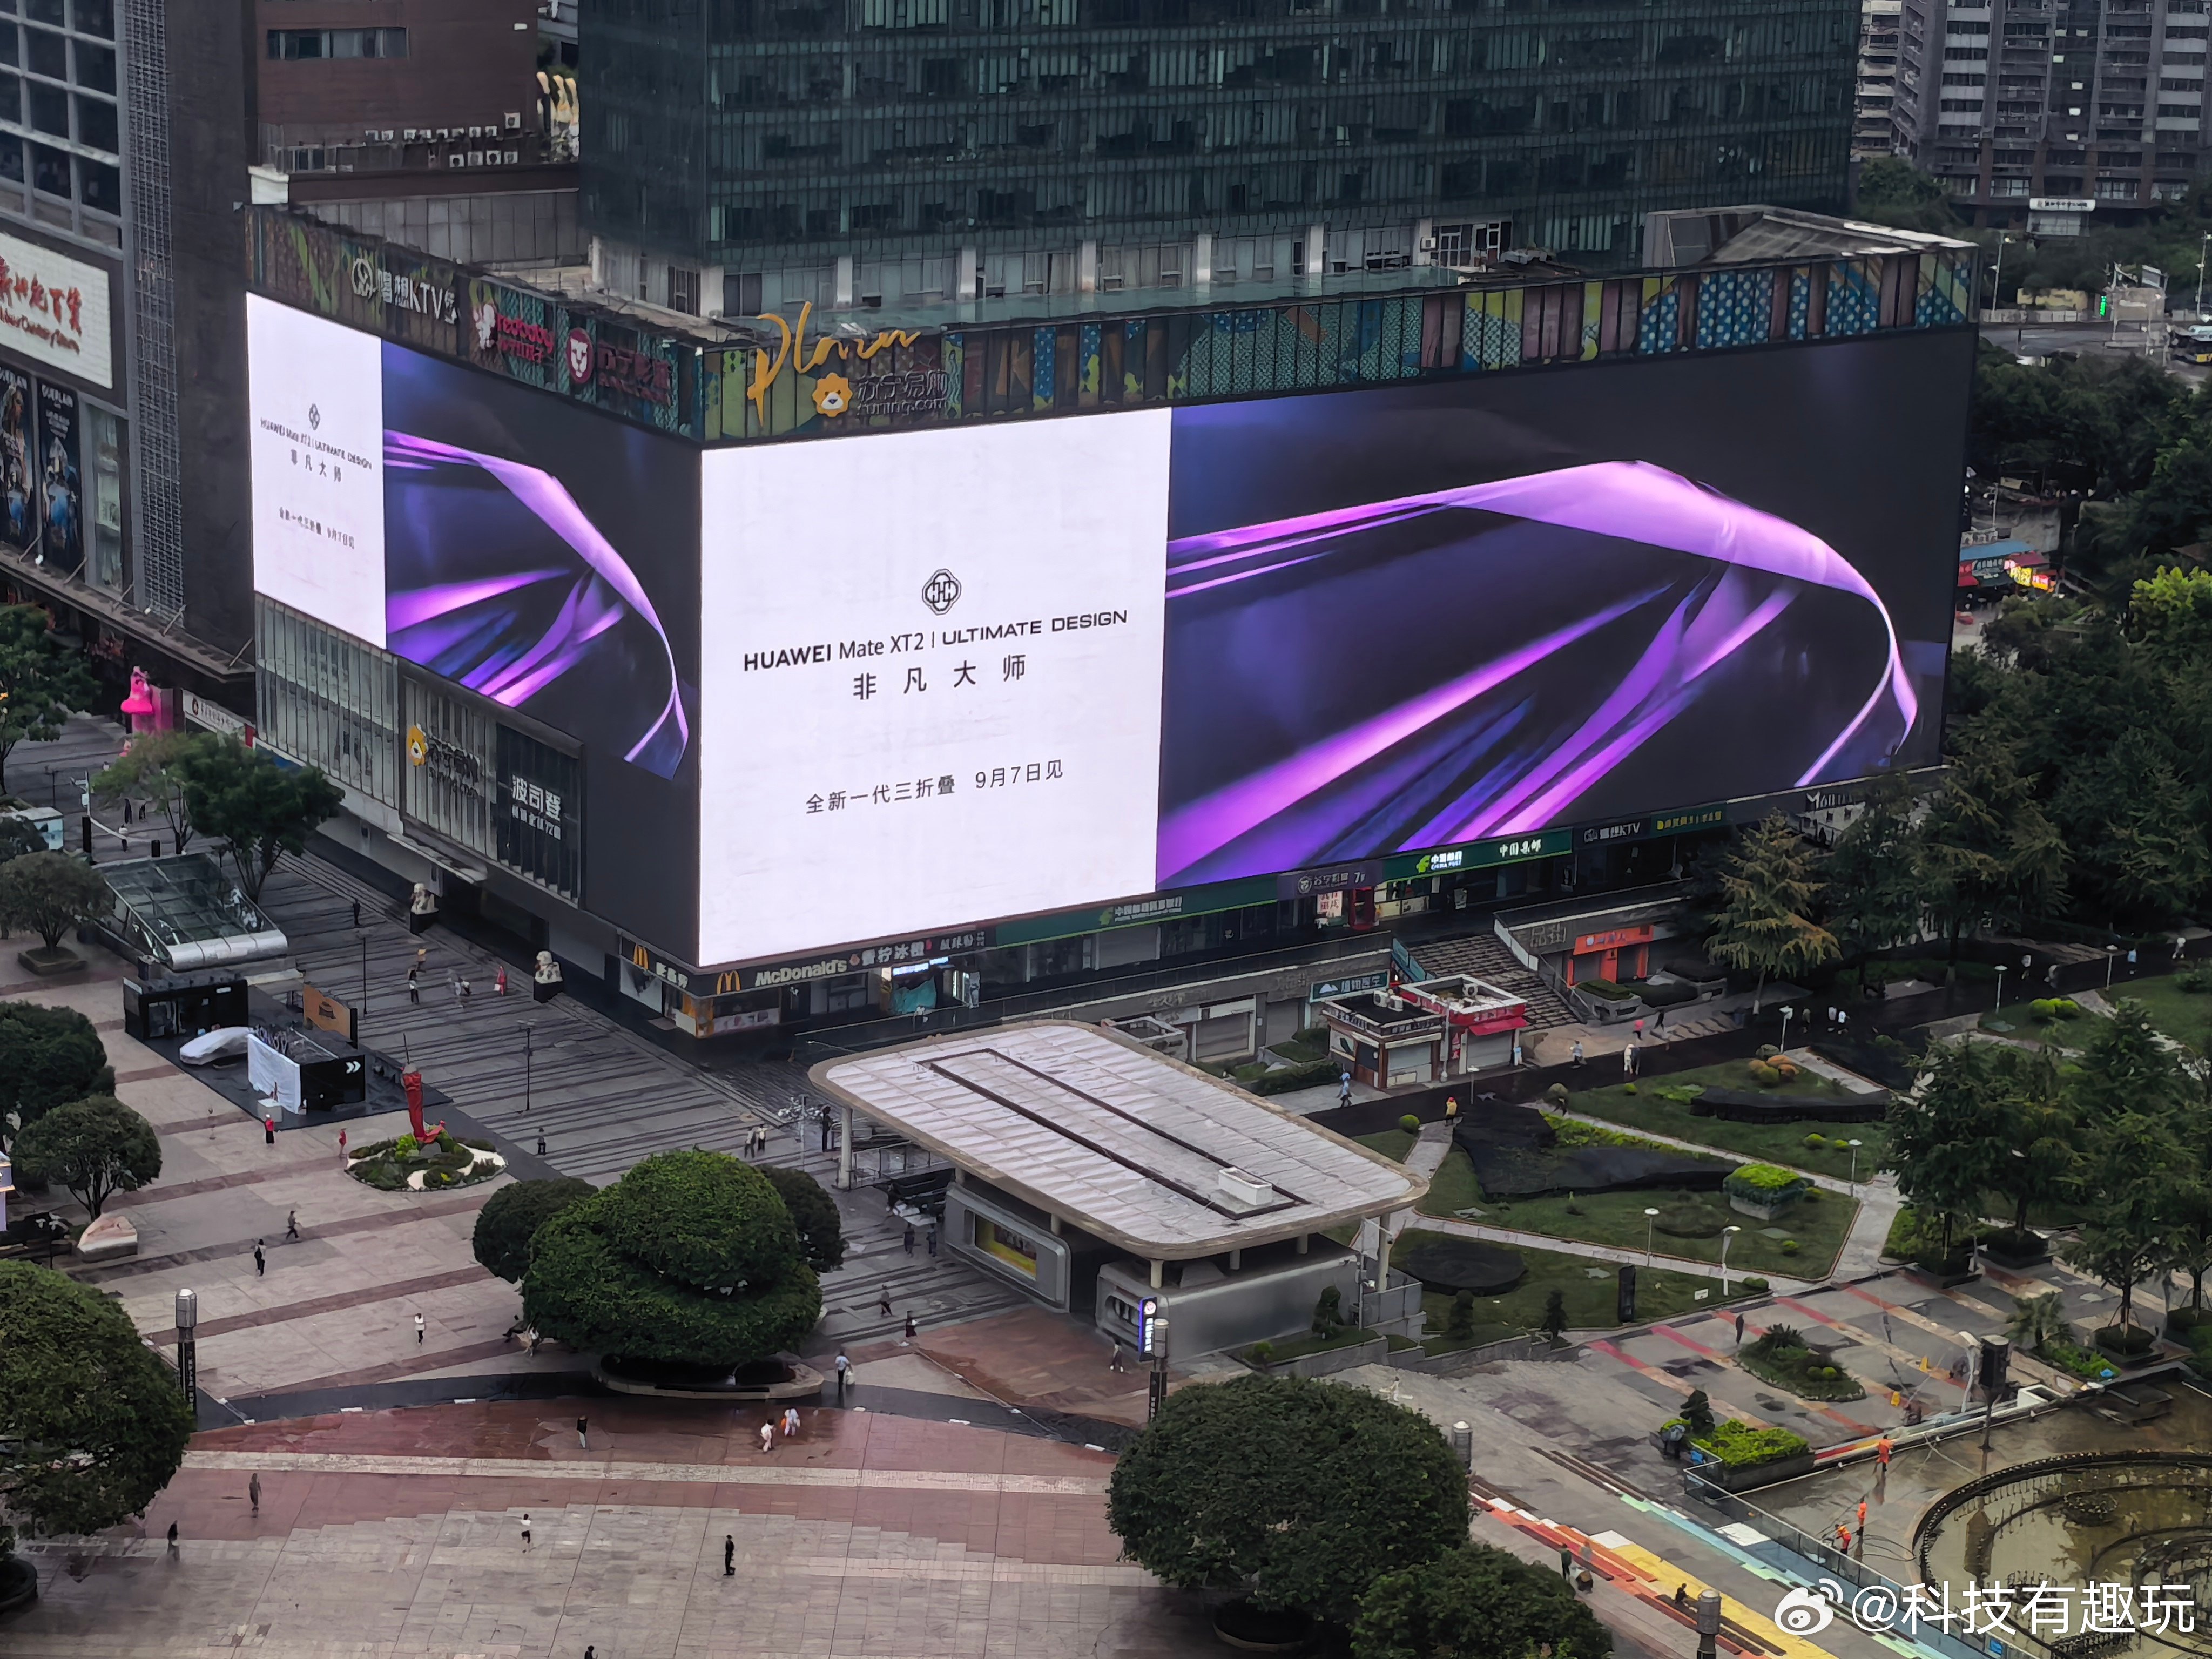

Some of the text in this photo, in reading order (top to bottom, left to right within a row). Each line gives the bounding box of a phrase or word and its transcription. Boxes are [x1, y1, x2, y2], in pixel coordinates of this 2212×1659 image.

[744, 610, 1128, 672] HUAWEI Mate XT2 ULTIMATE DESIGN
[853, 654, 1026, 700] 非凡大师
[512, 774, 561, 821] 波司登
[806, 759, 1063, 814] 全新一代三折叠 9月7日见
[754, 959, 848, 988] McDonald's
